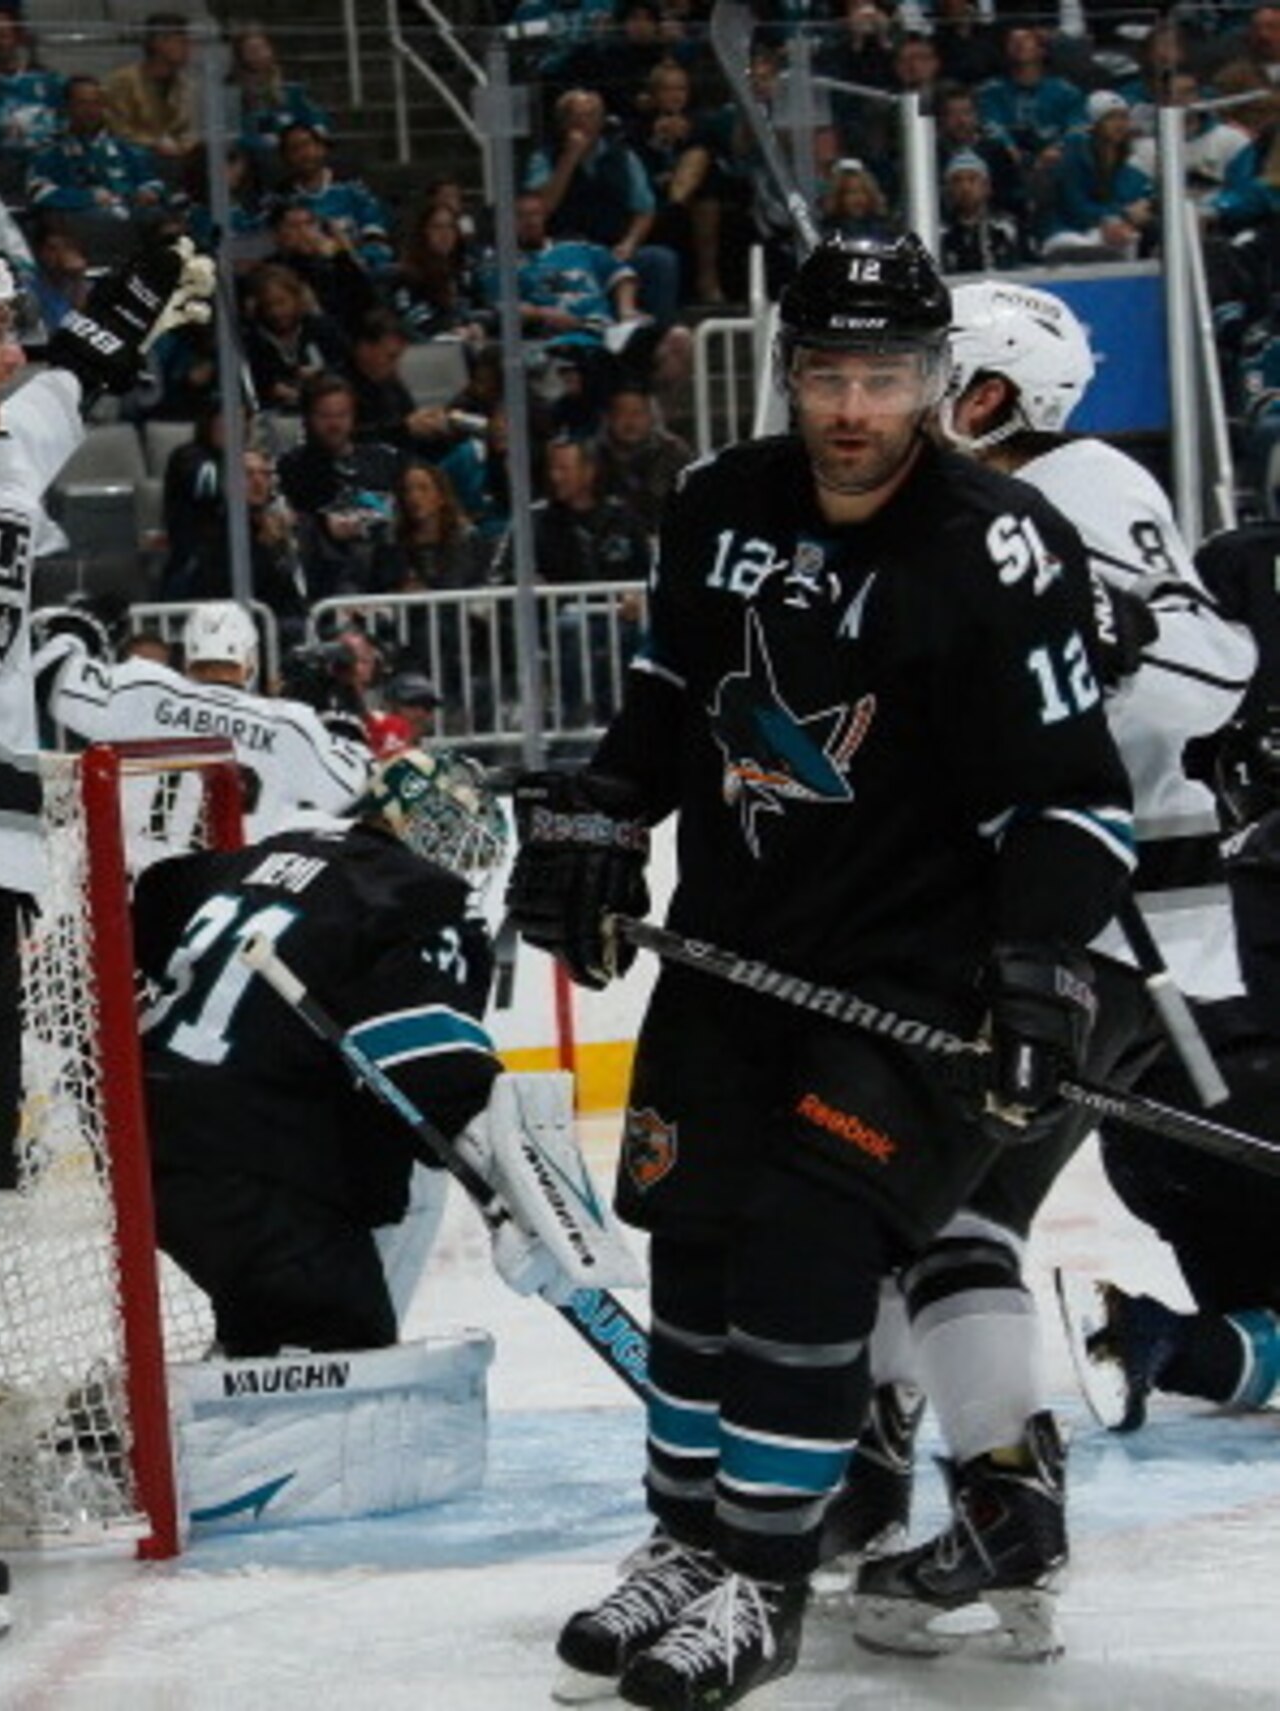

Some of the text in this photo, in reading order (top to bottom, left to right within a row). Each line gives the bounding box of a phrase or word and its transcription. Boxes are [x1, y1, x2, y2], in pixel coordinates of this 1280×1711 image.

[848, 258, 881, 281] 12
[706, 529, 777, 594] 12
[1028, 630, 1101, 725] 12
[155, 700, 277, 753] GABORIK
[137, 895, 299, 1067] 31
[797, 1093, 895, 1165] Reebok
[223, 1361, 350, 1397] VAUGHN
